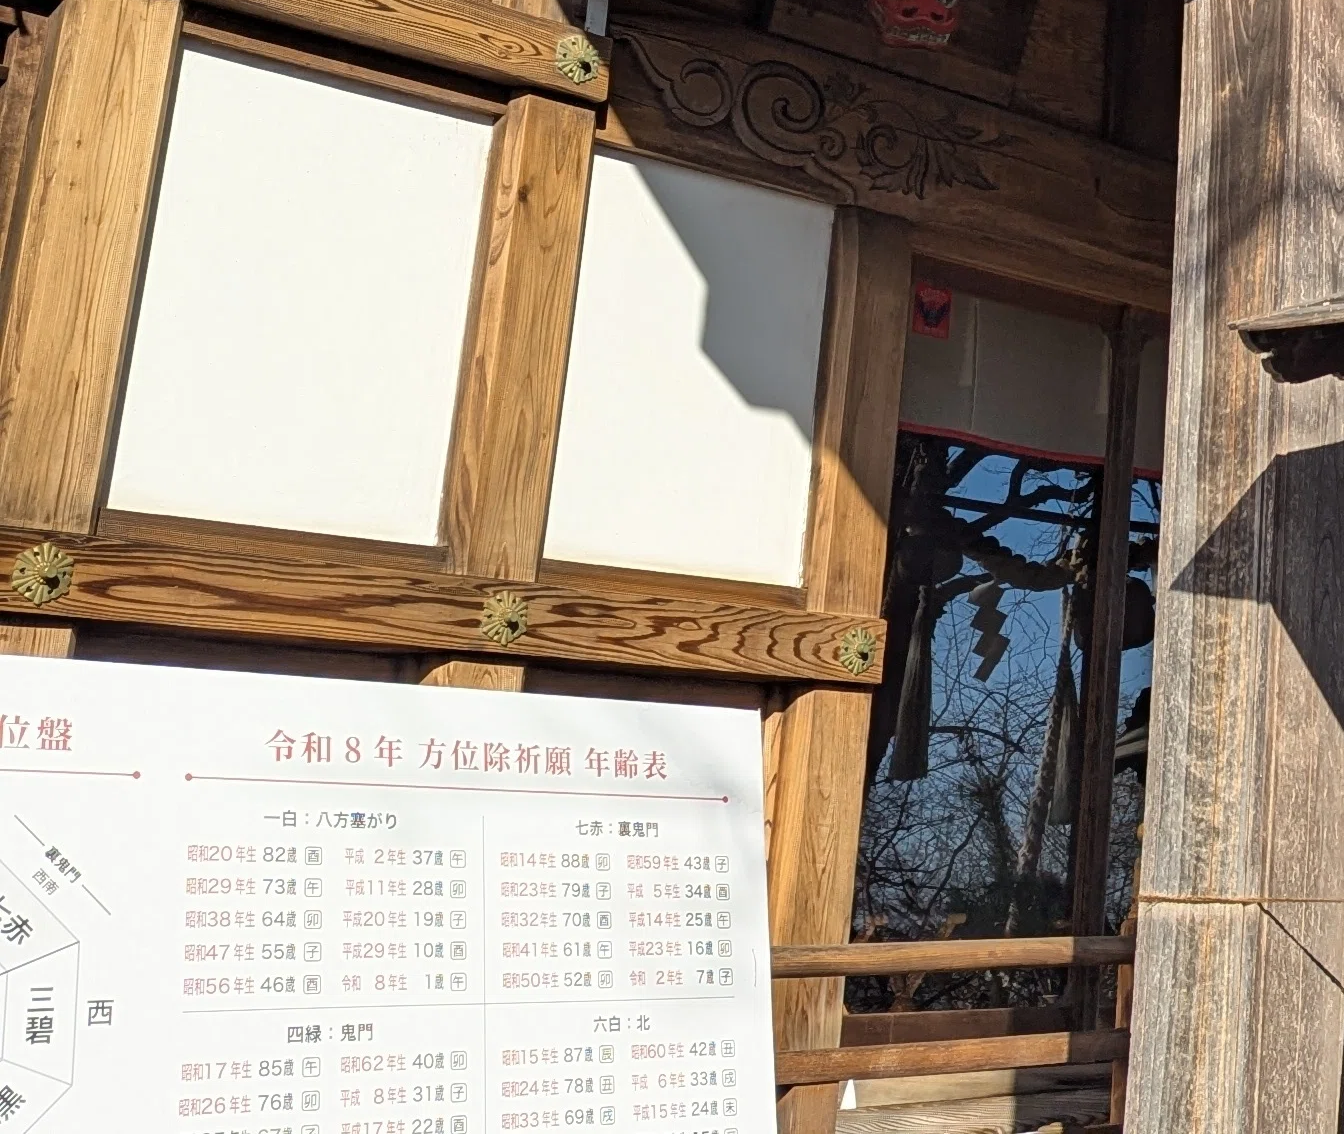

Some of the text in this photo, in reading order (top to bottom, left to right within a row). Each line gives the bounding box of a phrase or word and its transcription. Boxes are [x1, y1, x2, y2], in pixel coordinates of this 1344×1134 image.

[418, 738, 571, 776] 方位除祈願
[585, 747, 667, 782] 年齢表
[575, 820, 658, 837] 七赤：裏鬼門
[263, 847, 297, 863] 82歳
[413, 850, 443, 866] 37歳
[561, 854, 589, 869] 88歳
[684, 856, 710, 871] 43歳
[32, 868, 60, 895] 西南
[263, 878, 296, 895] 73歳
[413, 881, 443, 896] 28歳
[562, 883, 590, 898] 79歳
[685, 884, 711, 899] 34歳
[262, 910, 296, 927] 64歳
[414, 912, 444, 927] 19歳
[562, 912, 591, 927] 70歳
[686, 910, 712, 927] 25歳
[262, 943, 296, 960] 55歳
[414, 942, 444, 958] 10歳
[563, 942, 591, 957] 61歳
[688, 941, 713, 955] 16歳
[260, 975, 295, 993] 46歳
[426, 974, 444, 990] 1歳
[564, 972, 592, 987] 52歳
[696, 969, 714, 984] 7歳
[25, 987, 55, 1045] 三碧
[87, 1000, 114, 1026] 西
[594, 1015, 650, 1032] 六白：北
[564, 1047, 593, 1062] 87歳
[689, 1041, 716, 1056] 42歳
[259, 1058, 294, 1077] 85歳
[412, 1052, 444, 1069] 40歳
[564, 1078, 594, 1093] 78歳
[691, 1071, 717, 1086] 33歳
[258, 1093, 293, 1111] 76歳
[413, 1084, 444, 1102] 31歳
[565, 1108, 594, 1125] 69歳
[692, 1100, 718, 1116] 24歳
